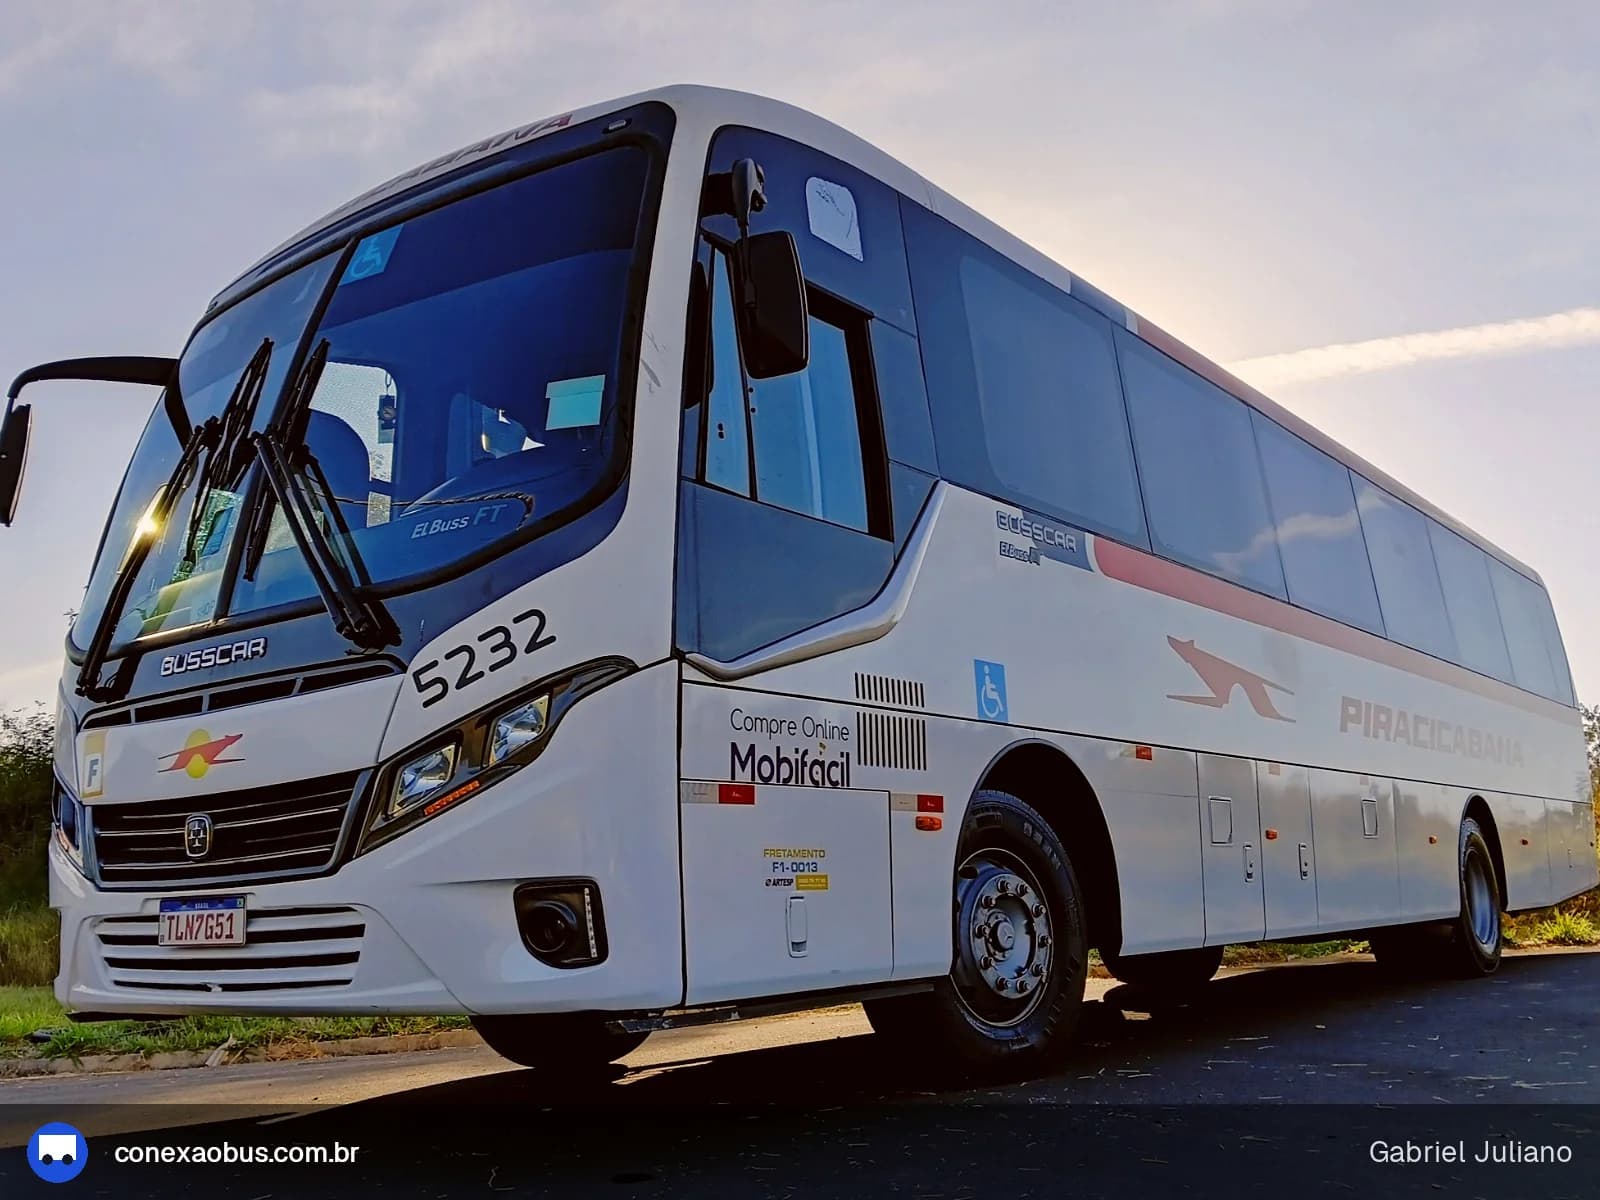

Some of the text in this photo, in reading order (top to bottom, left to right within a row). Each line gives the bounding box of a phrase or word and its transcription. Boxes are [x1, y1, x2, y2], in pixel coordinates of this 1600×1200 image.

[473, 504, 508, 526] FT
[995, 510, 1077, 552] BUSSCAR
[160, 637, 267, 677] BUSSCAR
[412, 608, 557, 708] 5232
[730, 708, 850, 741] Compre Online
[87, 758, 100, 787] F
[763, 848, 826, 859] FRETAMENTO
[772, 861, 818, 873] F1-0013
[167, 912, 234, 941] TLN7G51
